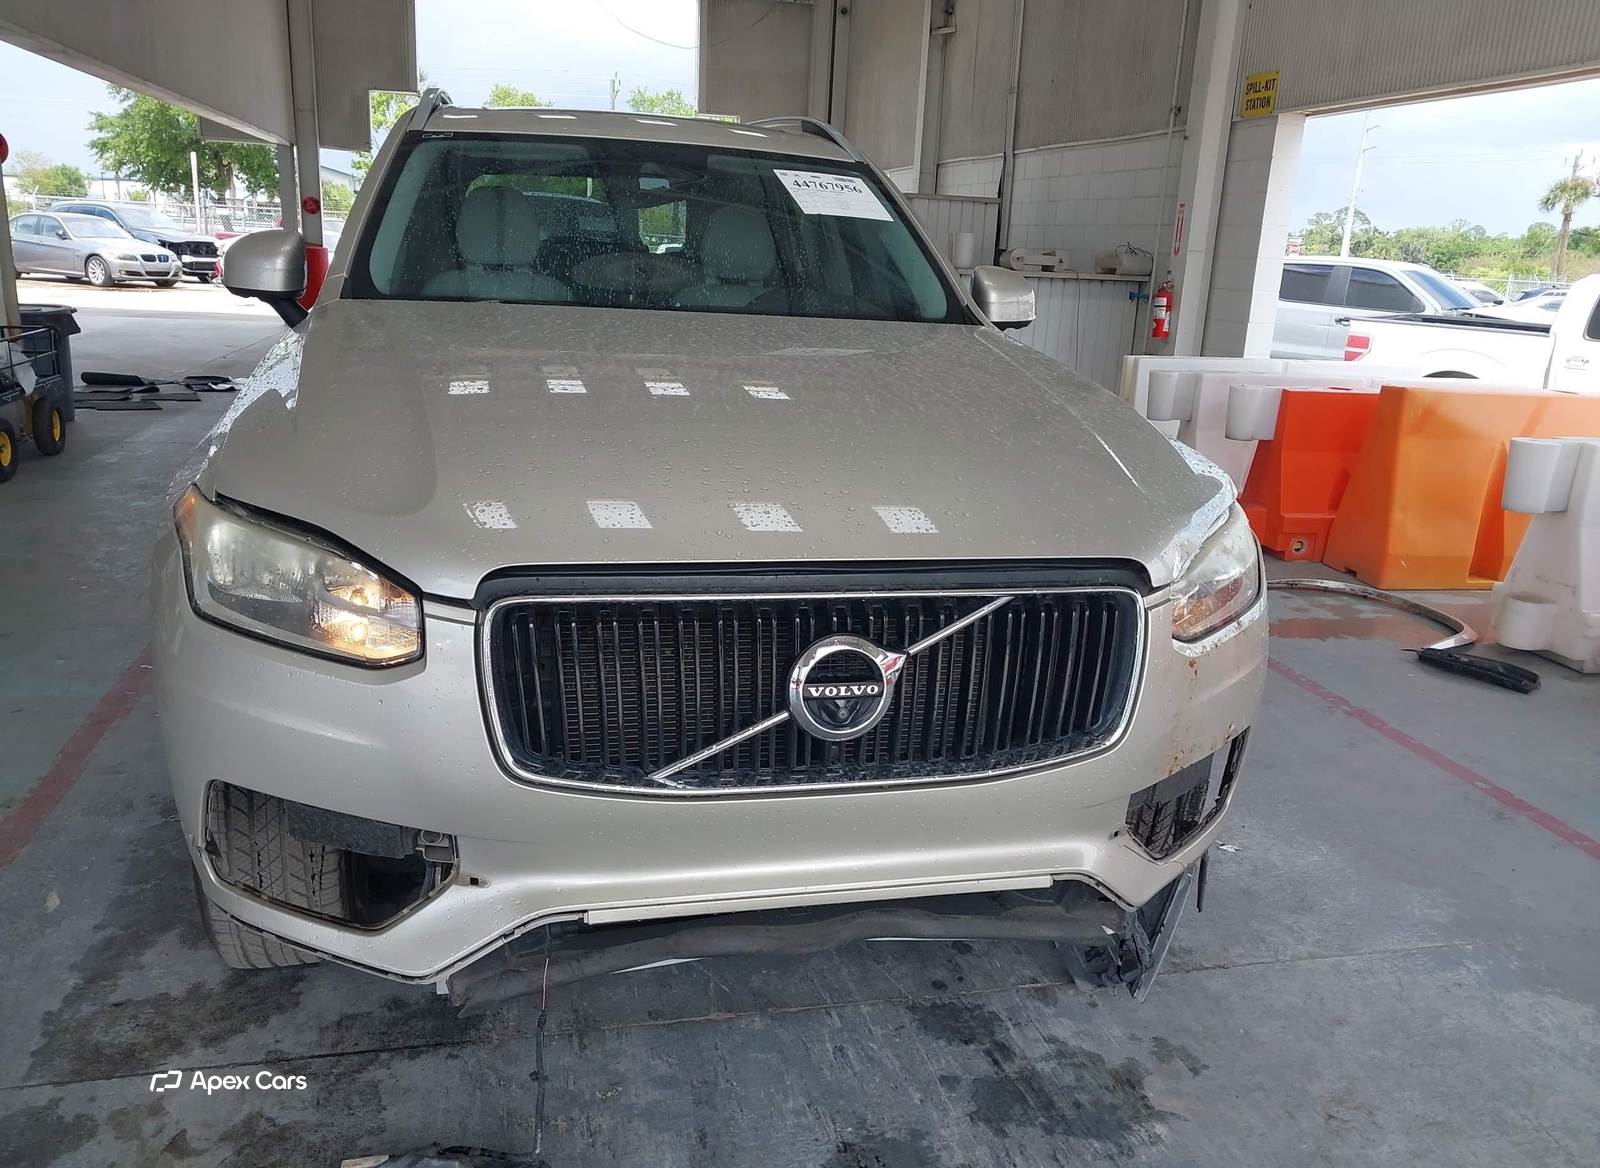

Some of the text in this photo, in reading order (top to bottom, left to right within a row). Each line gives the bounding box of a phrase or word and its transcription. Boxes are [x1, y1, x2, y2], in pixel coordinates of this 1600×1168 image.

[1246, 78, 1277, 95] SPILL-KIT
[1245, 95, 1271, 111] STATION
[792, 179, 863, 194] 44767956
[807, 684, 879, 697] VOLVO
